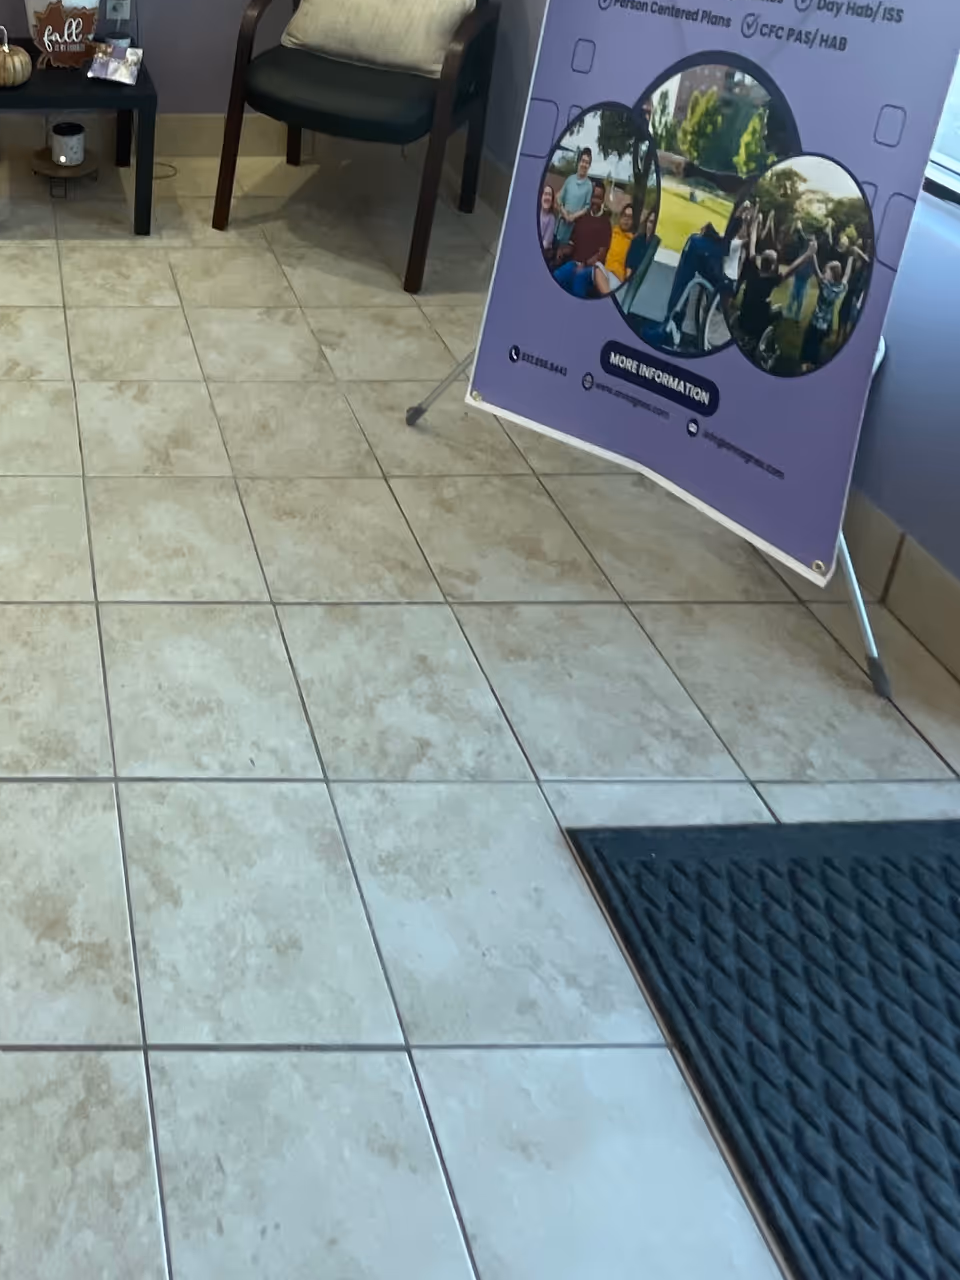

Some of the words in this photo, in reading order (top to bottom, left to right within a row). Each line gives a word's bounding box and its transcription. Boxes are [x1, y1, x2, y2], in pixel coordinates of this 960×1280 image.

[650, 1, 700, 22] Centered
[700, 9, 732, 28] Plans
[43, 17, 83, 52] fall
[759, 23, 784, 40] CFC
[609, 351, 638, 374] MORE
[638, 363, 710, 406] INFORMATION
